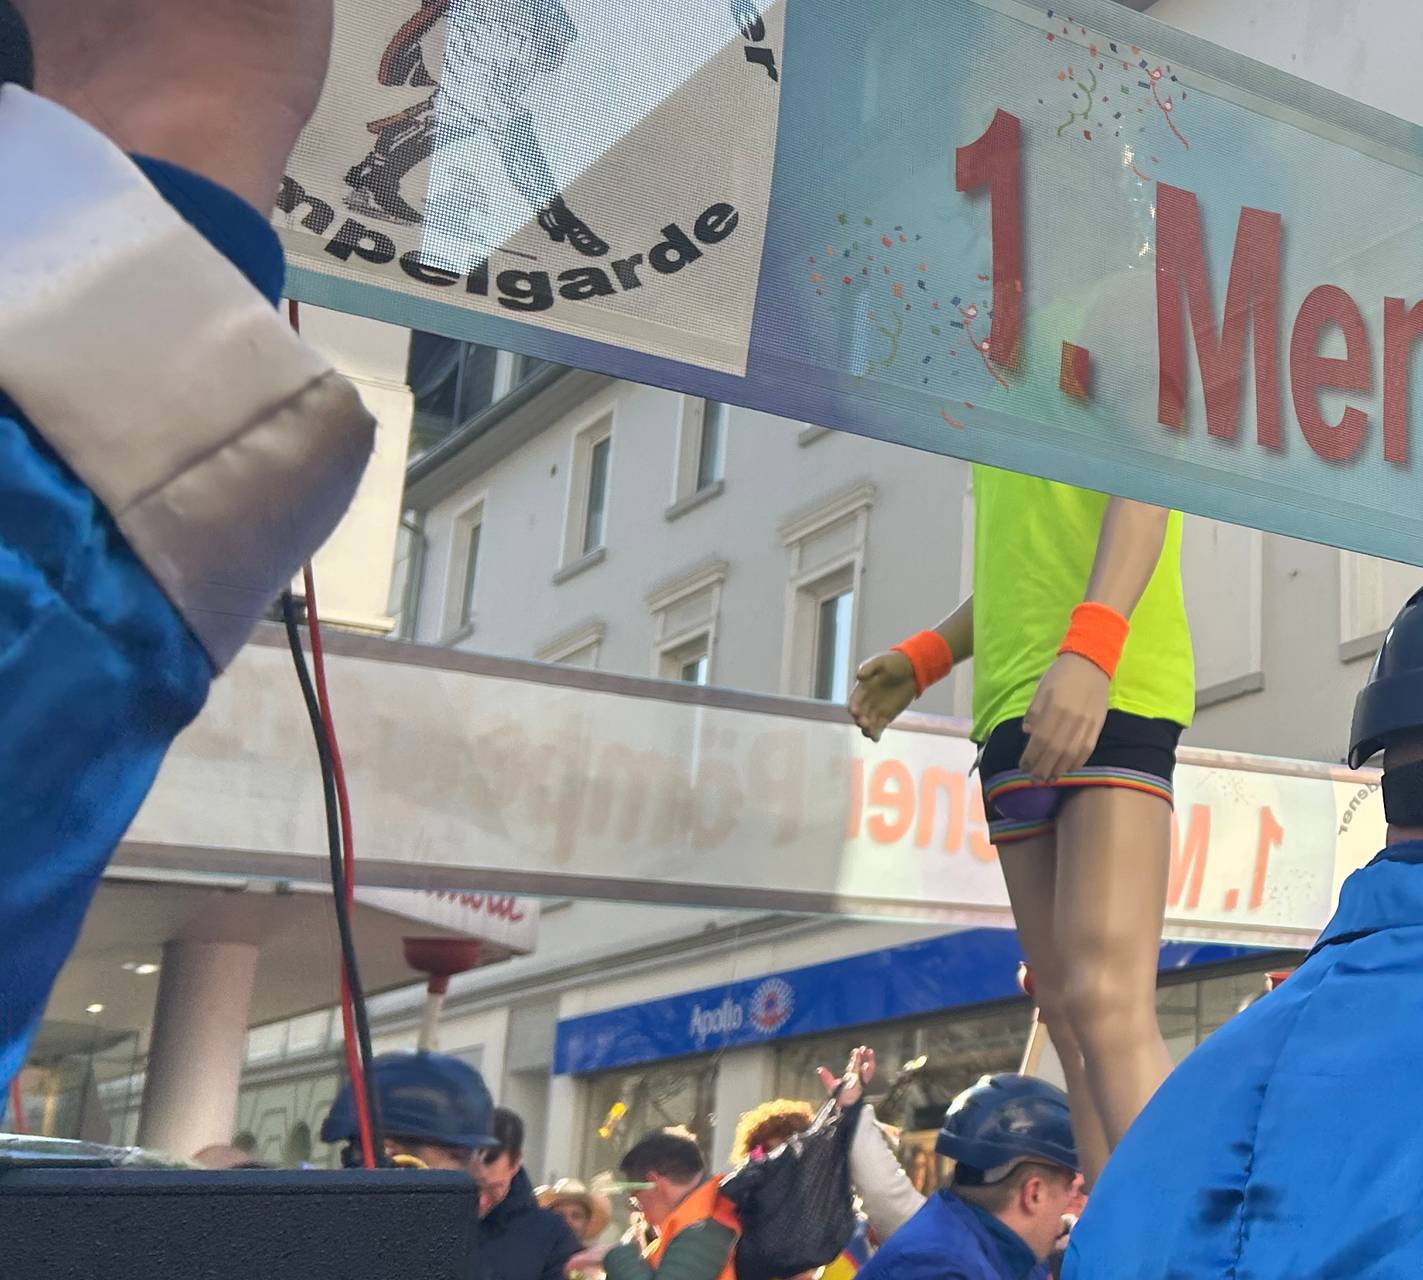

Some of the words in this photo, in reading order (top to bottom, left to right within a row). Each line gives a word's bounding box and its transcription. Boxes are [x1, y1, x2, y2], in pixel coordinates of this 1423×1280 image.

[275, 174, 739, 312] mpelgarde
[956, 108, 1090, 399] 1.
[689, 996, 743, 1044] Apollo
